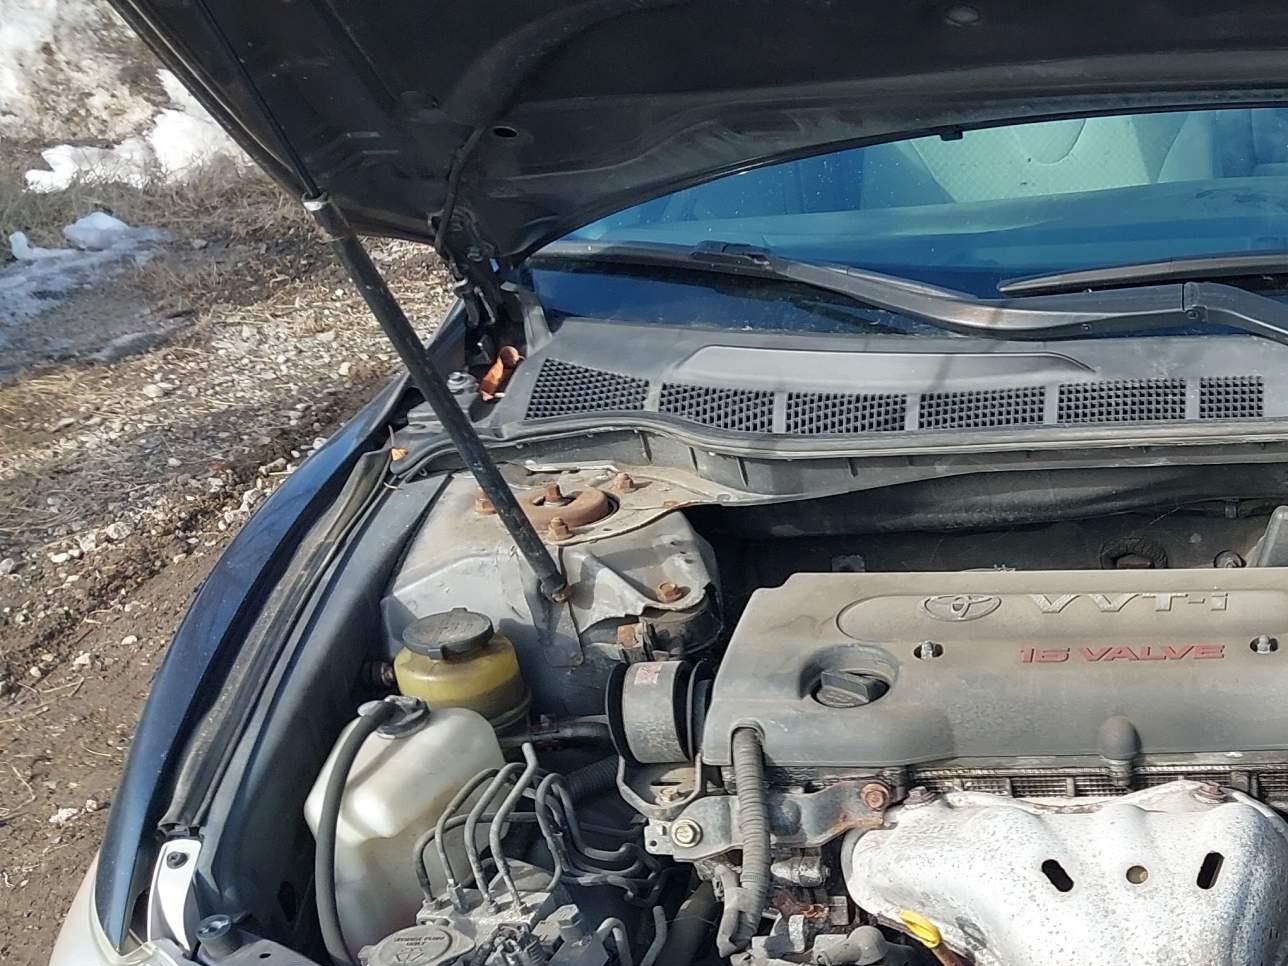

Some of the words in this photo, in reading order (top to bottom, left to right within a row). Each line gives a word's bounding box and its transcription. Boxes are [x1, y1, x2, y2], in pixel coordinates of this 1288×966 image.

[1028, 592, 1229, 614] VVT-i
[1020, 647, 1071, 663] 16
[1080, 644, 1226, 662] VALVE
